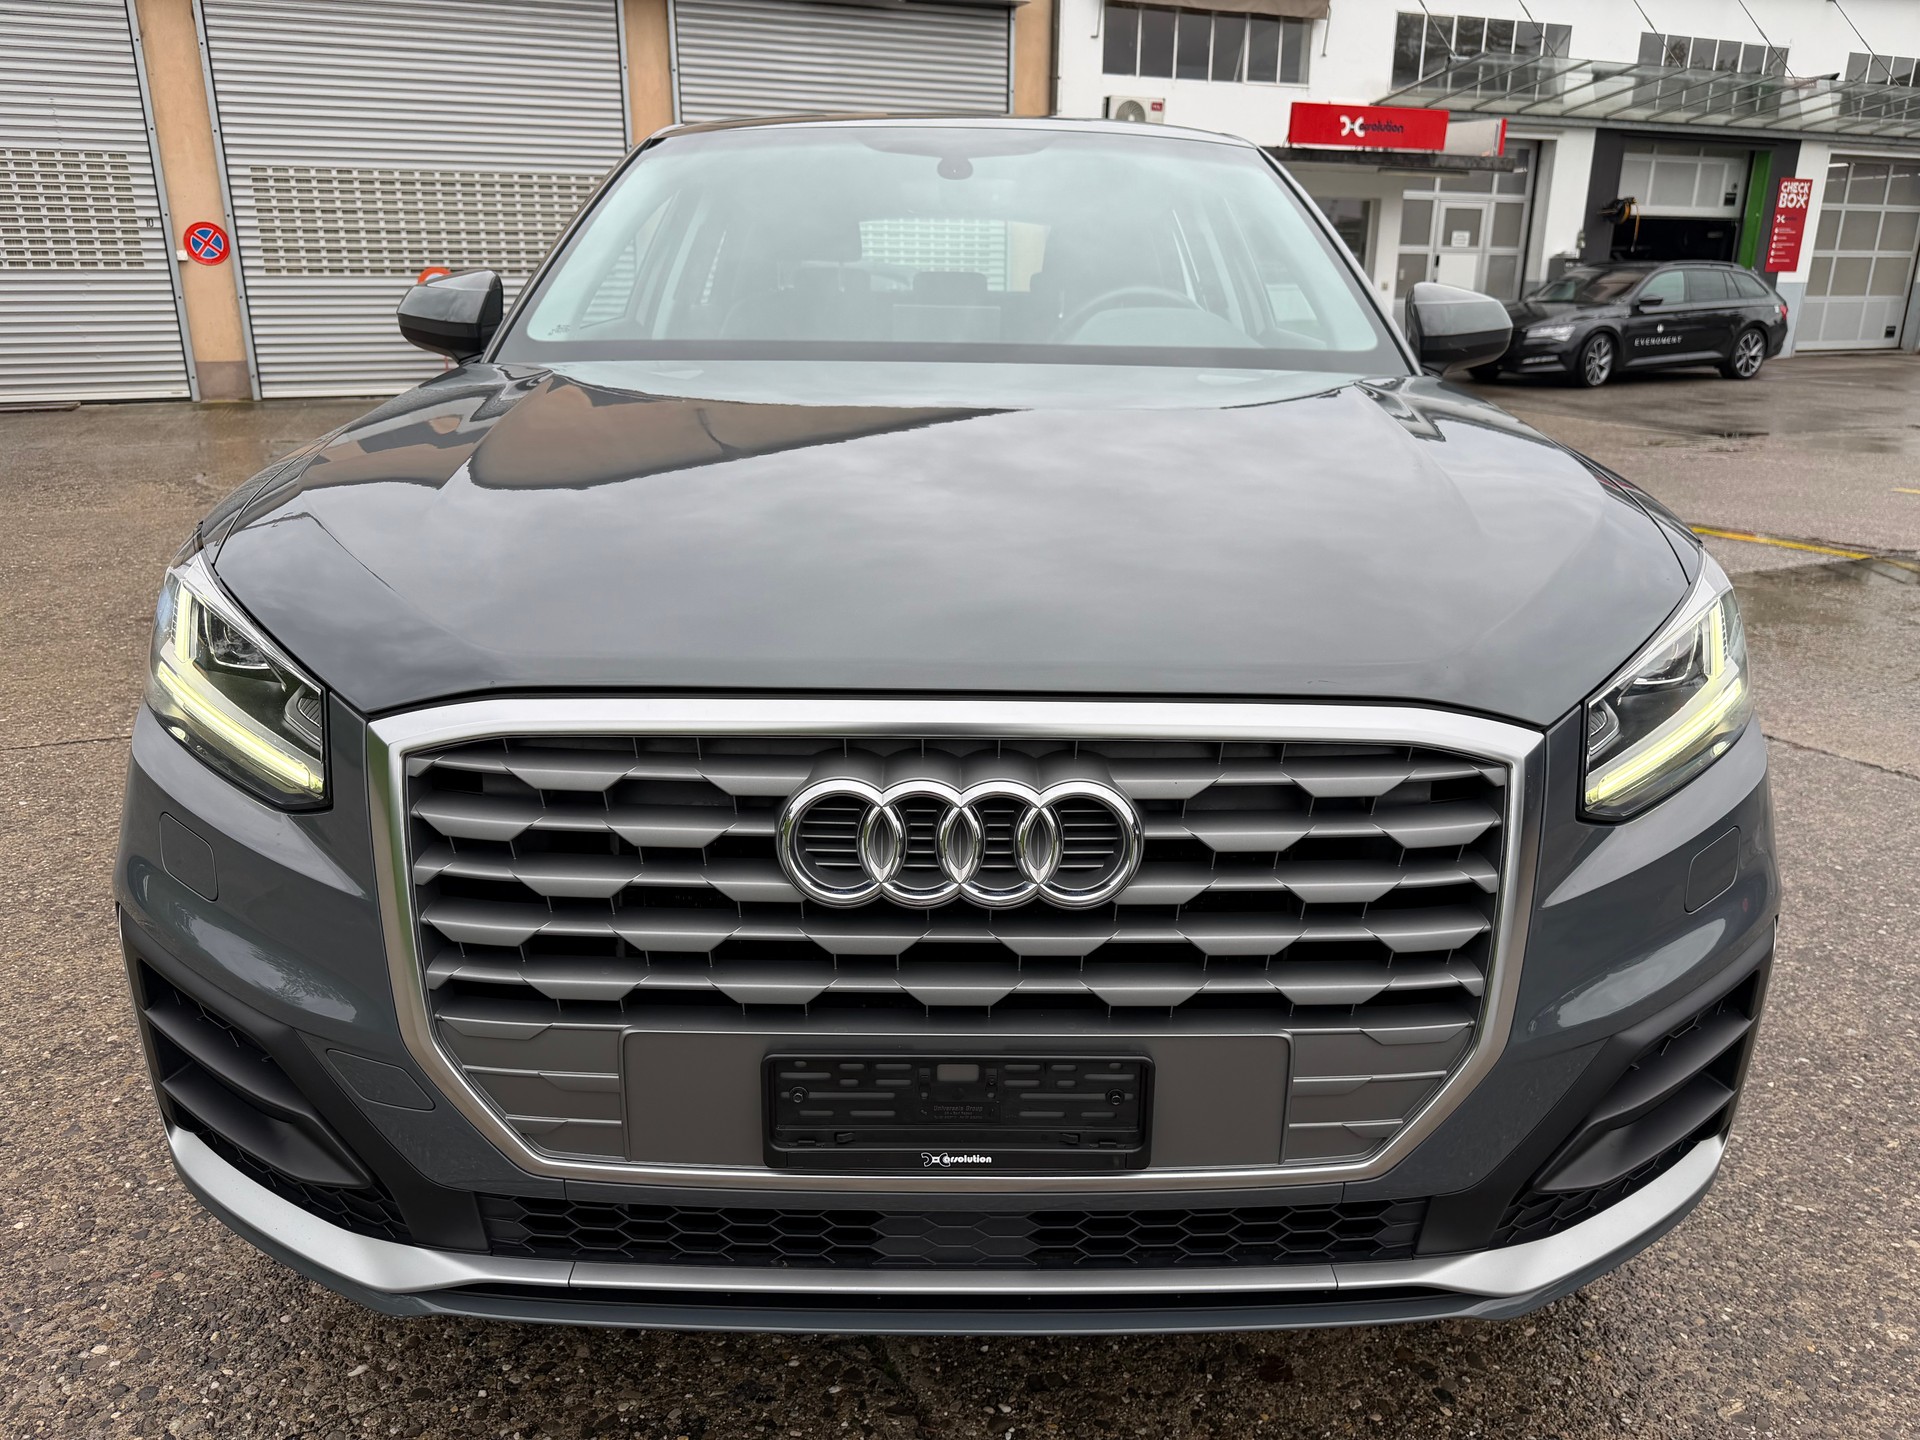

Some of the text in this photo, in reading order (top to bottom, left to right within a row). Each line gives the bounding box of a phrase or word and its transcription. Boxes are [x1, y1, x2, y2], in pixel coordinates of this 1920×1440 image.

[1781, 181, 1810, 194] CHECK
[1778, 193, 1808, 209] BOX
[145, 218, 153, 227] 10
